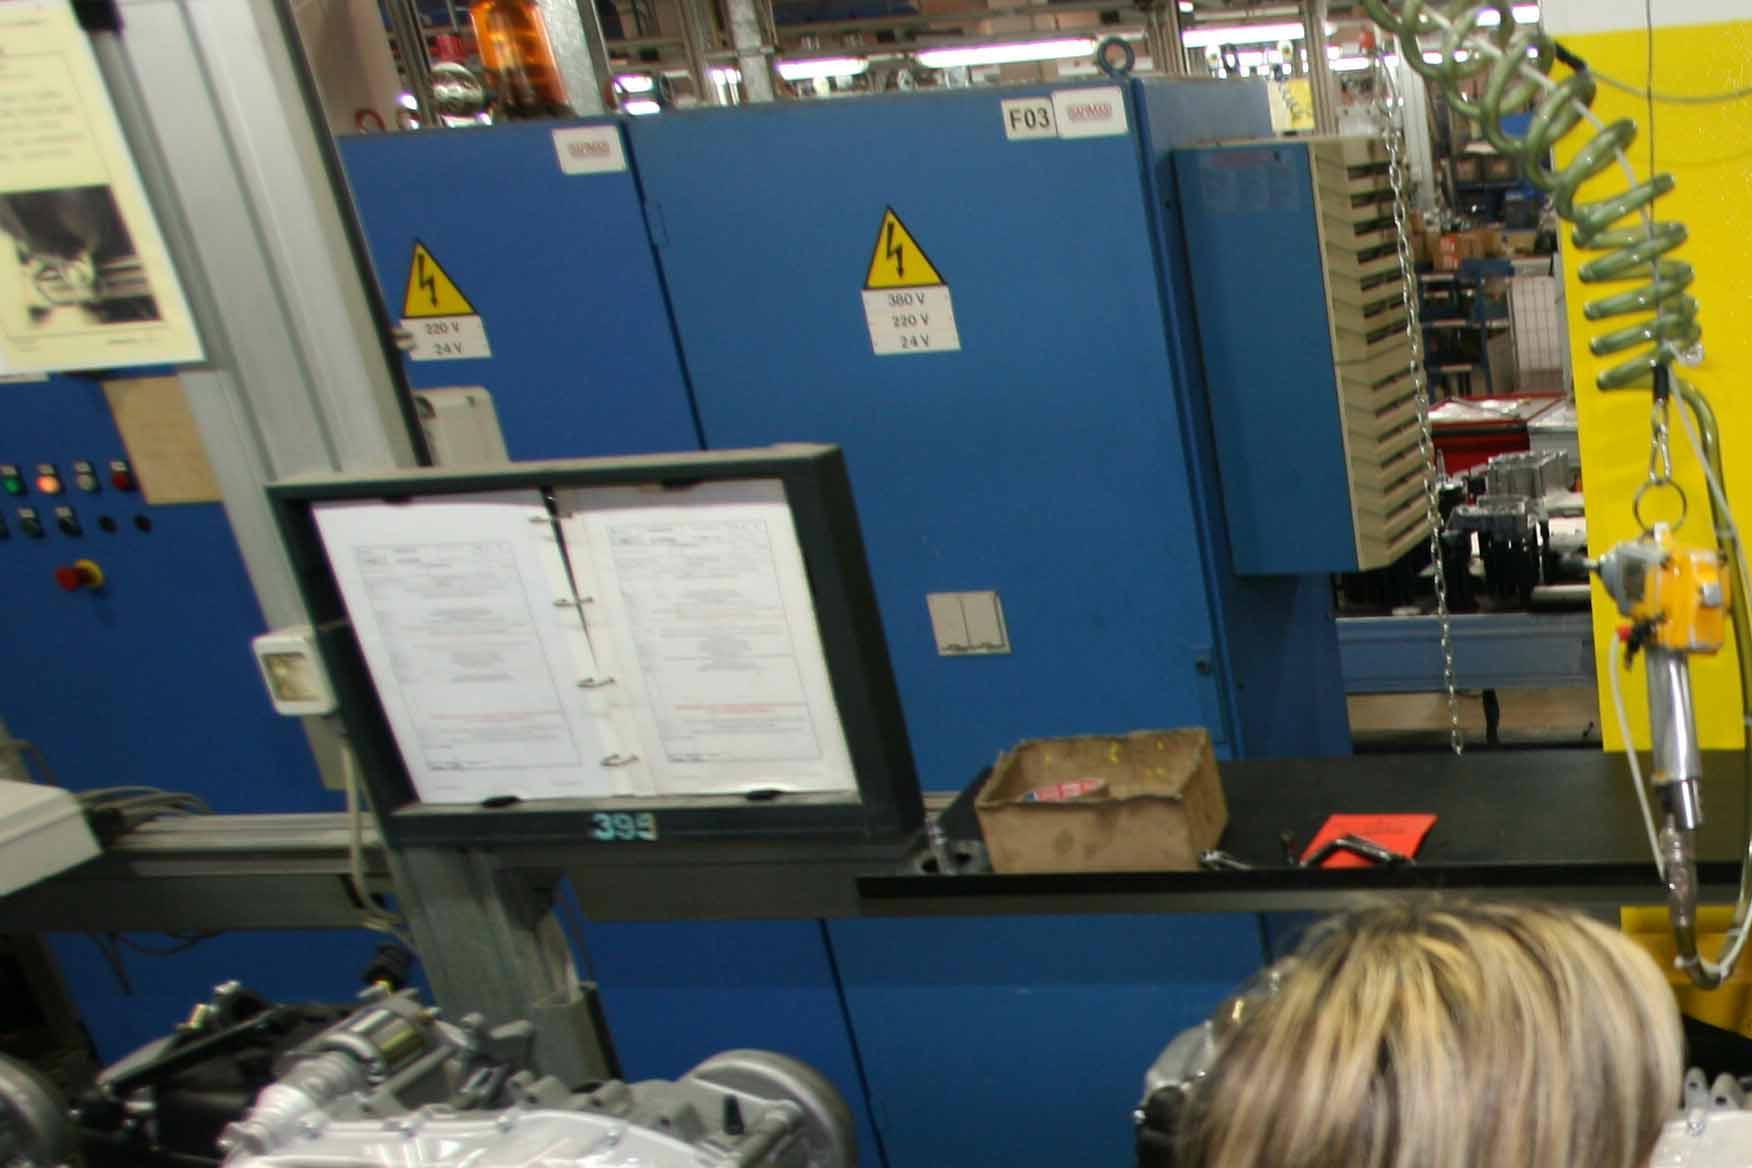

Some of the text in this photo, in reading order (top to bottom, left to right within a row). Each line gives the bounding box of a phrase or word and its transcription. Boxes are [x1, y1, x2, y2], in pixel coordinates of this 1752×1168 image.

[1008, 107, 1050, 131] F03
[888, 292, 925, 306] 380 V
[892, 312, 929, 328] 220 V
[426, 321, 460, 335] 220 V
[900, 334, 929, 349] 24 V
[433, 342, 462, 356] 24 V
